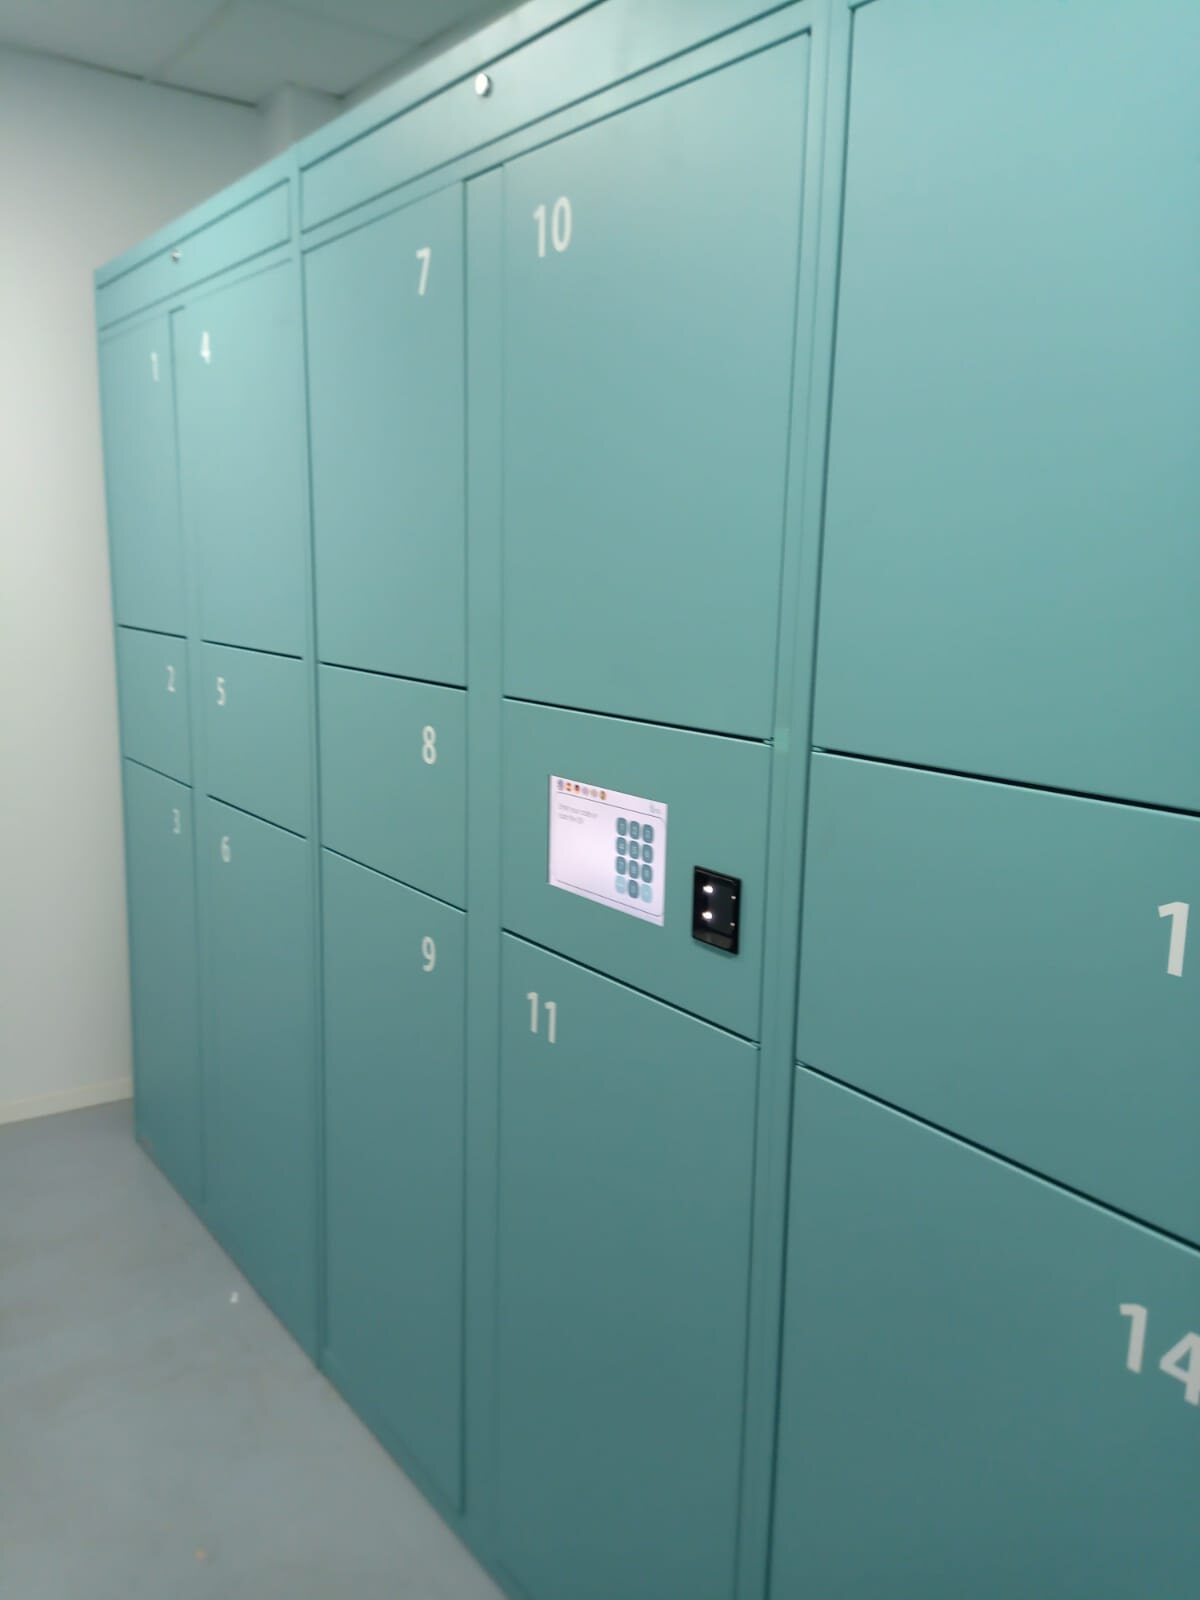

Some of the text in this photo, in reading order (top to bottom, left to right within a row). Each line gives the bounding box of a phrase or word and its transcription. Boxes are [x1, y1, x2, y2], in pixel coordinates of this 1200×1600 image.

[533, 195, 573, 258] 10
[414, 246, 432, 297] 7
[199, 331, 211, 364] 4
[149, 351, 160, 382] 1
[166, 664, 176, 693] 2
[215, 676, 226, 706] 5
[421, 725, 437, 765] 8
[172, 807, 181, 835] 3
[220, 834, 231, 864] 6
[421, 935, 436, 973] 9
[526, 991, 558, 1044] 11
[1119, 1302, 1200, 1406] 14
